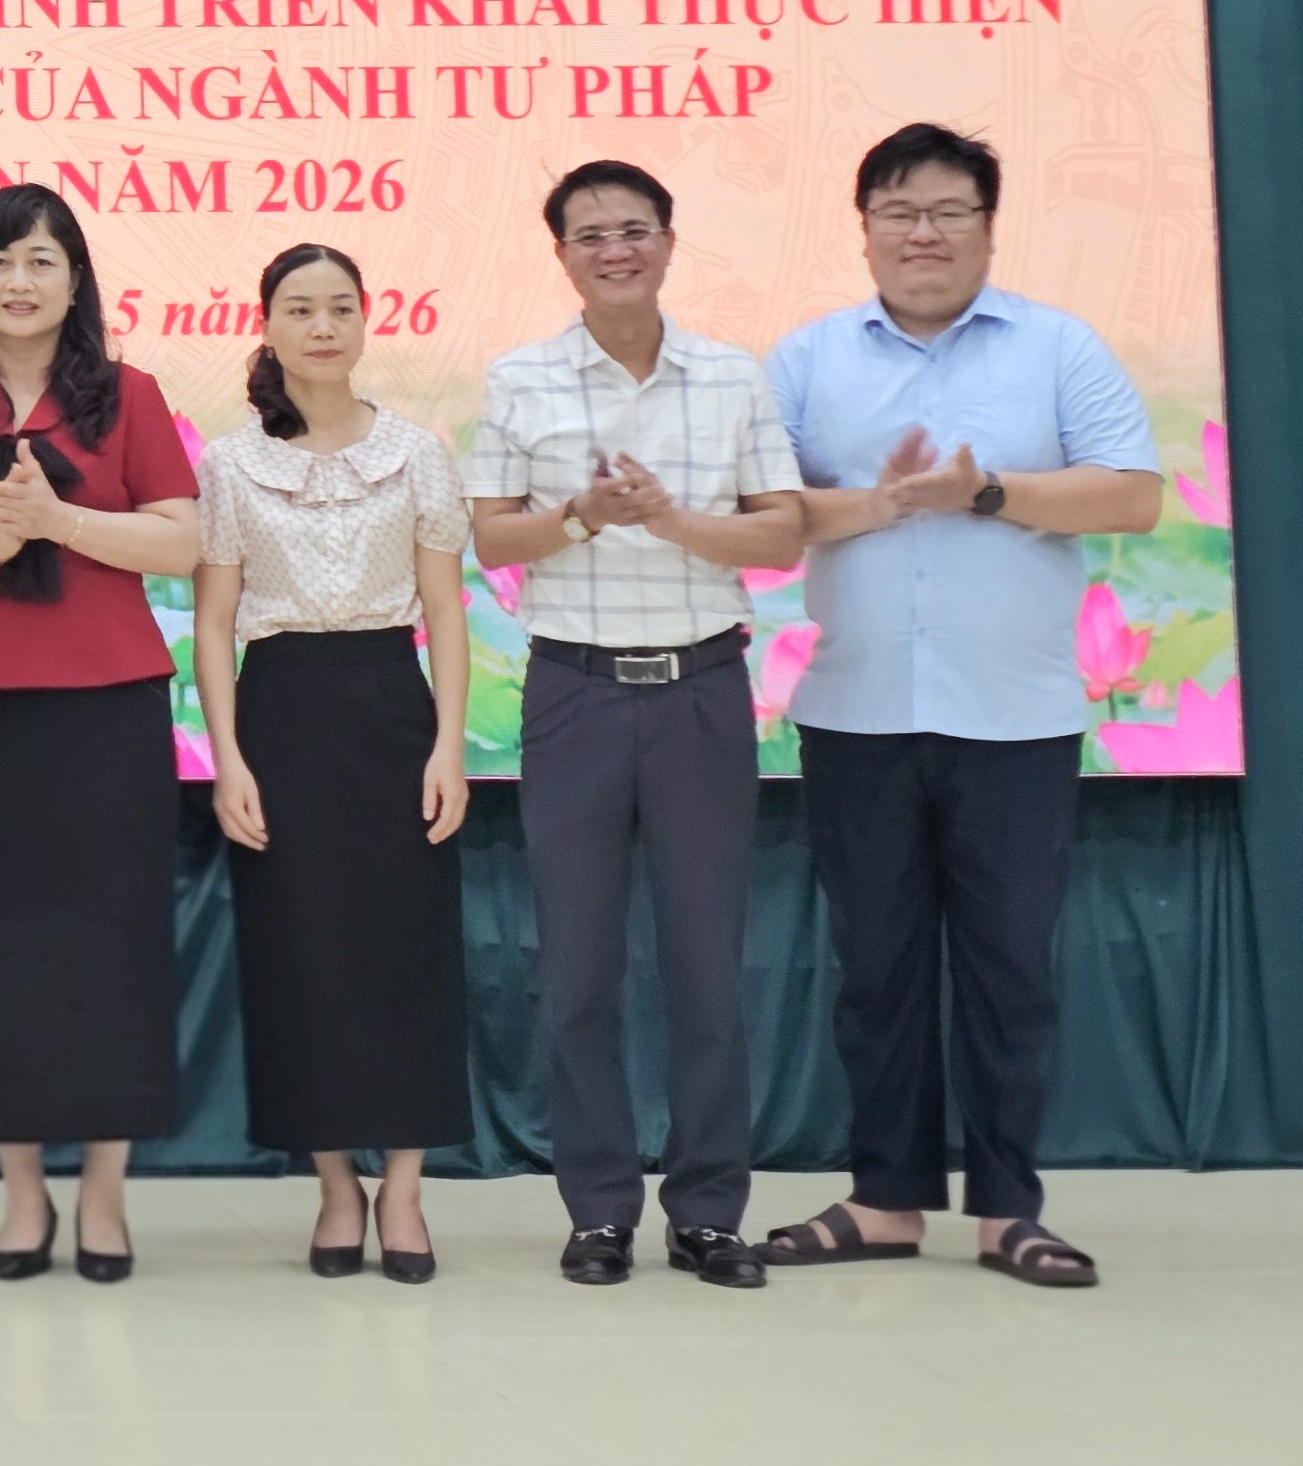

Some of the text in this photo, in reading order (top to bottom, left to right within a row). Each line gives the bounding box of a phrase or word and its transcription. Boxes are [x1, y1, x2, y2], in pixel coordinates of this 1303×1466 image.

[133, 49, 415, 121] NGÀNH
[434, 56, 552, 121] TƯ
[568, 47, 776, 119] PHÁP
[52, 144, 233, 214] NĂM
[254, 158, 407, 213] 2026
[109, 289, 145, 337] 5
[361, 288, 440, 337] 26
